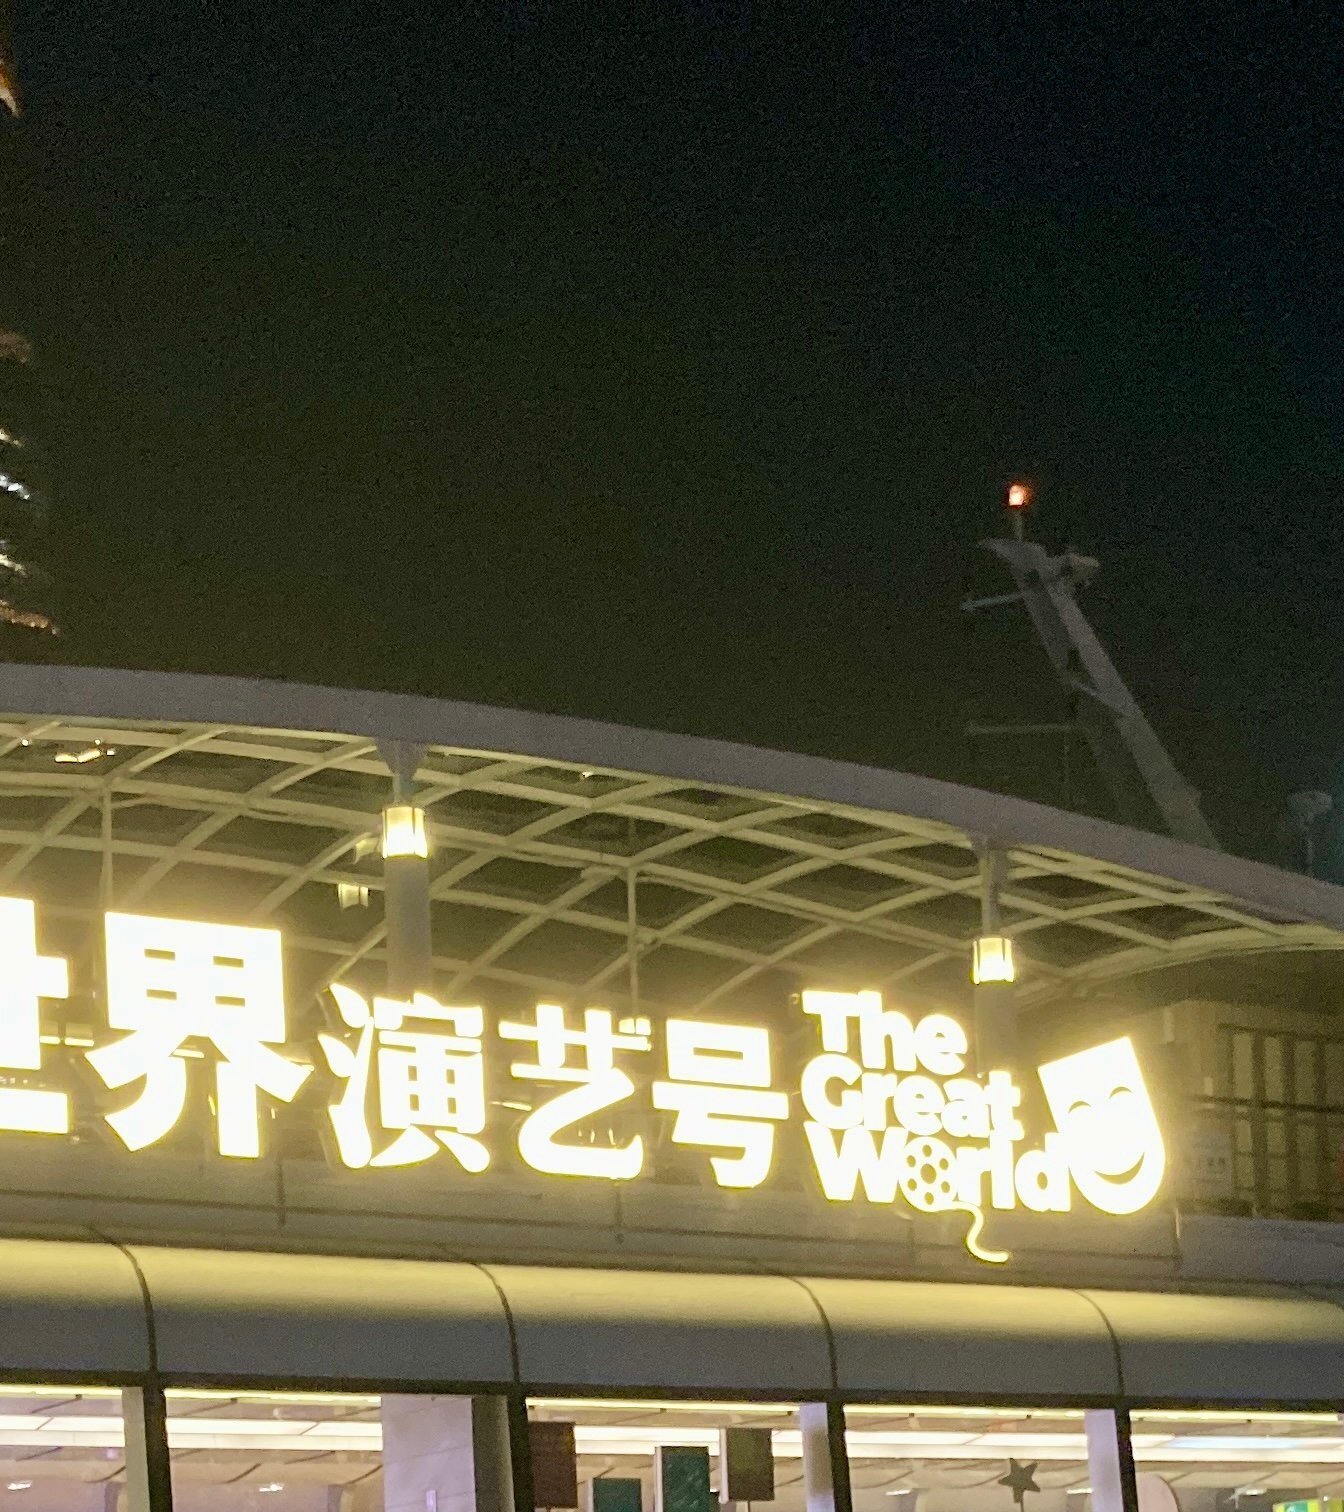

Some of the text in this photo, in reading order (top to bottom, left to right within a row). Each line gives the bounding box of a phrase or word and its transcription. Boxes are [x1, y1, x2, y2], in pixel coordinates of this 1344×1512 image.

[801, 989, 968, 1075] The
[800, 1052, 1025, 1141] Great
[803, 1120, 1072, 1213] World
